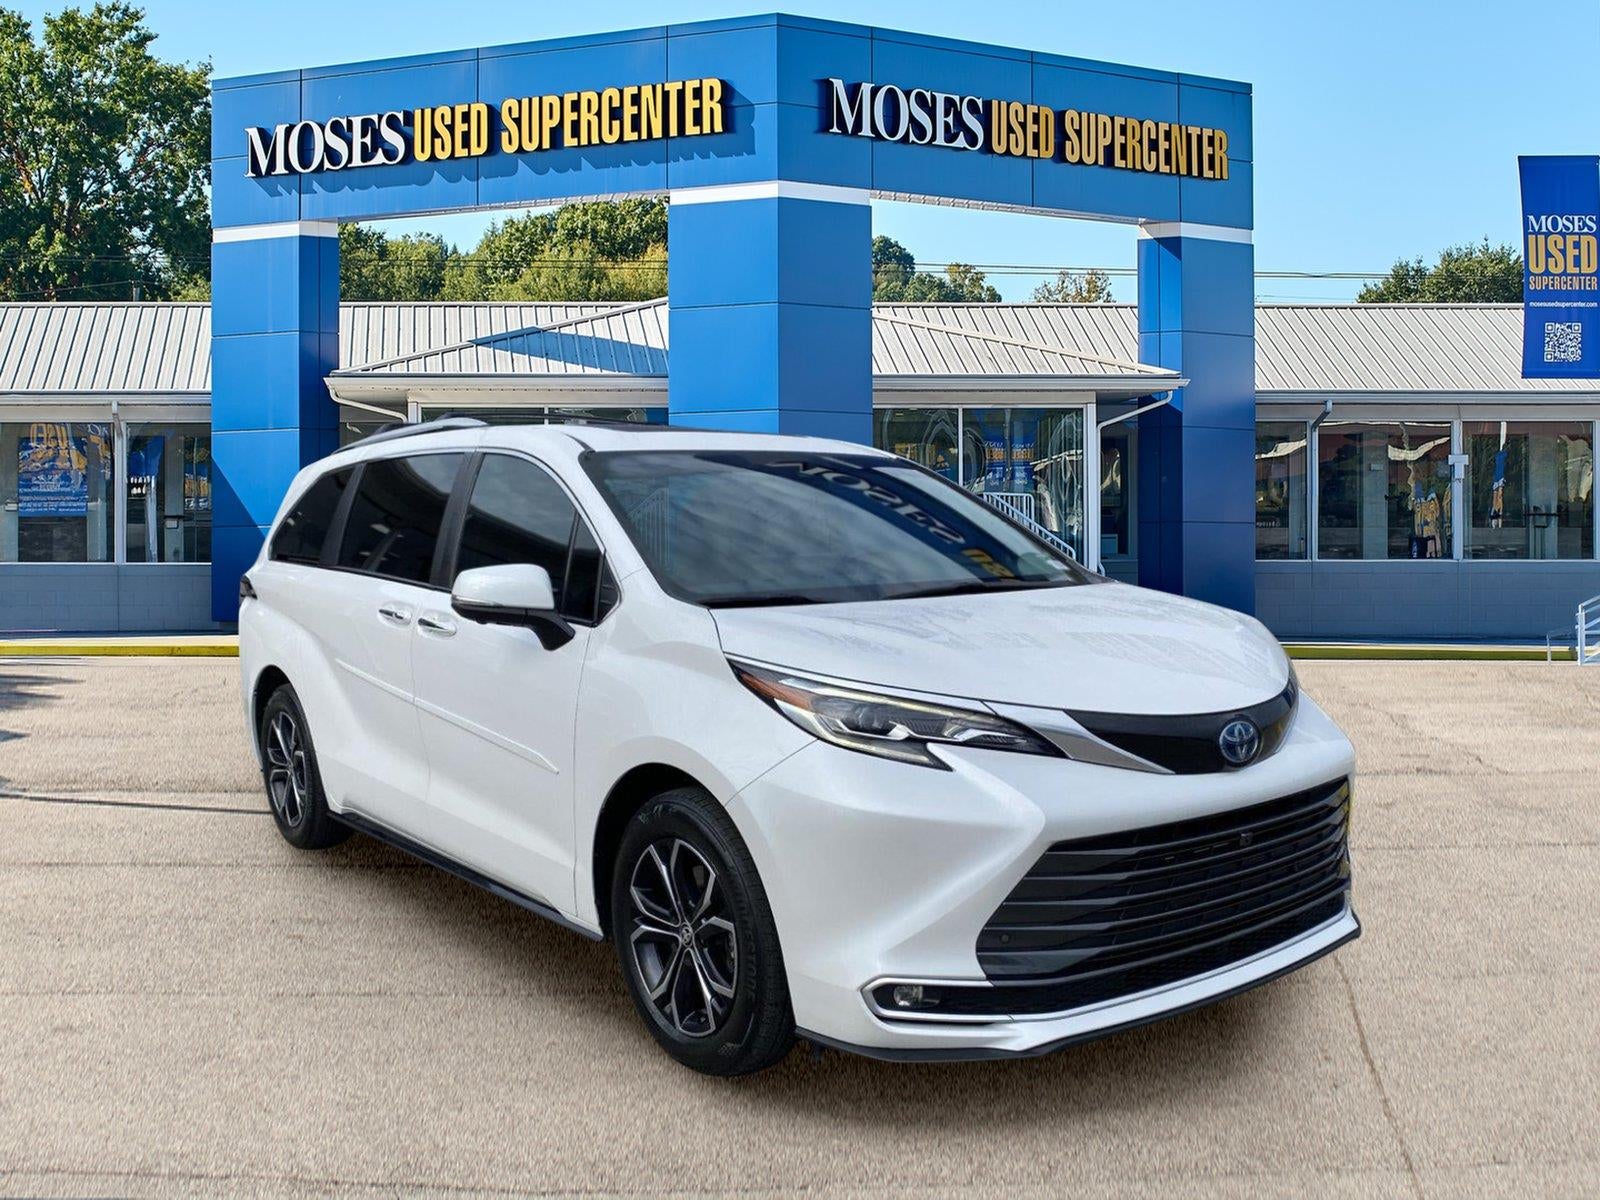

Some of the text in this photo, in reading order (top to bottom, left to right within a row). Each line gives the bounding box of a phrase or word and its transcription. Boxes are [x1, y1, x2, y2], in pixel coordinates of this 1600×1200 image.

[244, 77, 724, 178] MOSES USED SUPERCENTER
[827, 77, 1229, 181] MOSES USED SUPERCENTER
[1527, 215, 1597, 233] MOSES
[1528, 235, 1598, 274] USED
[1529, 275, 1598, 290] SUPERCENTER
